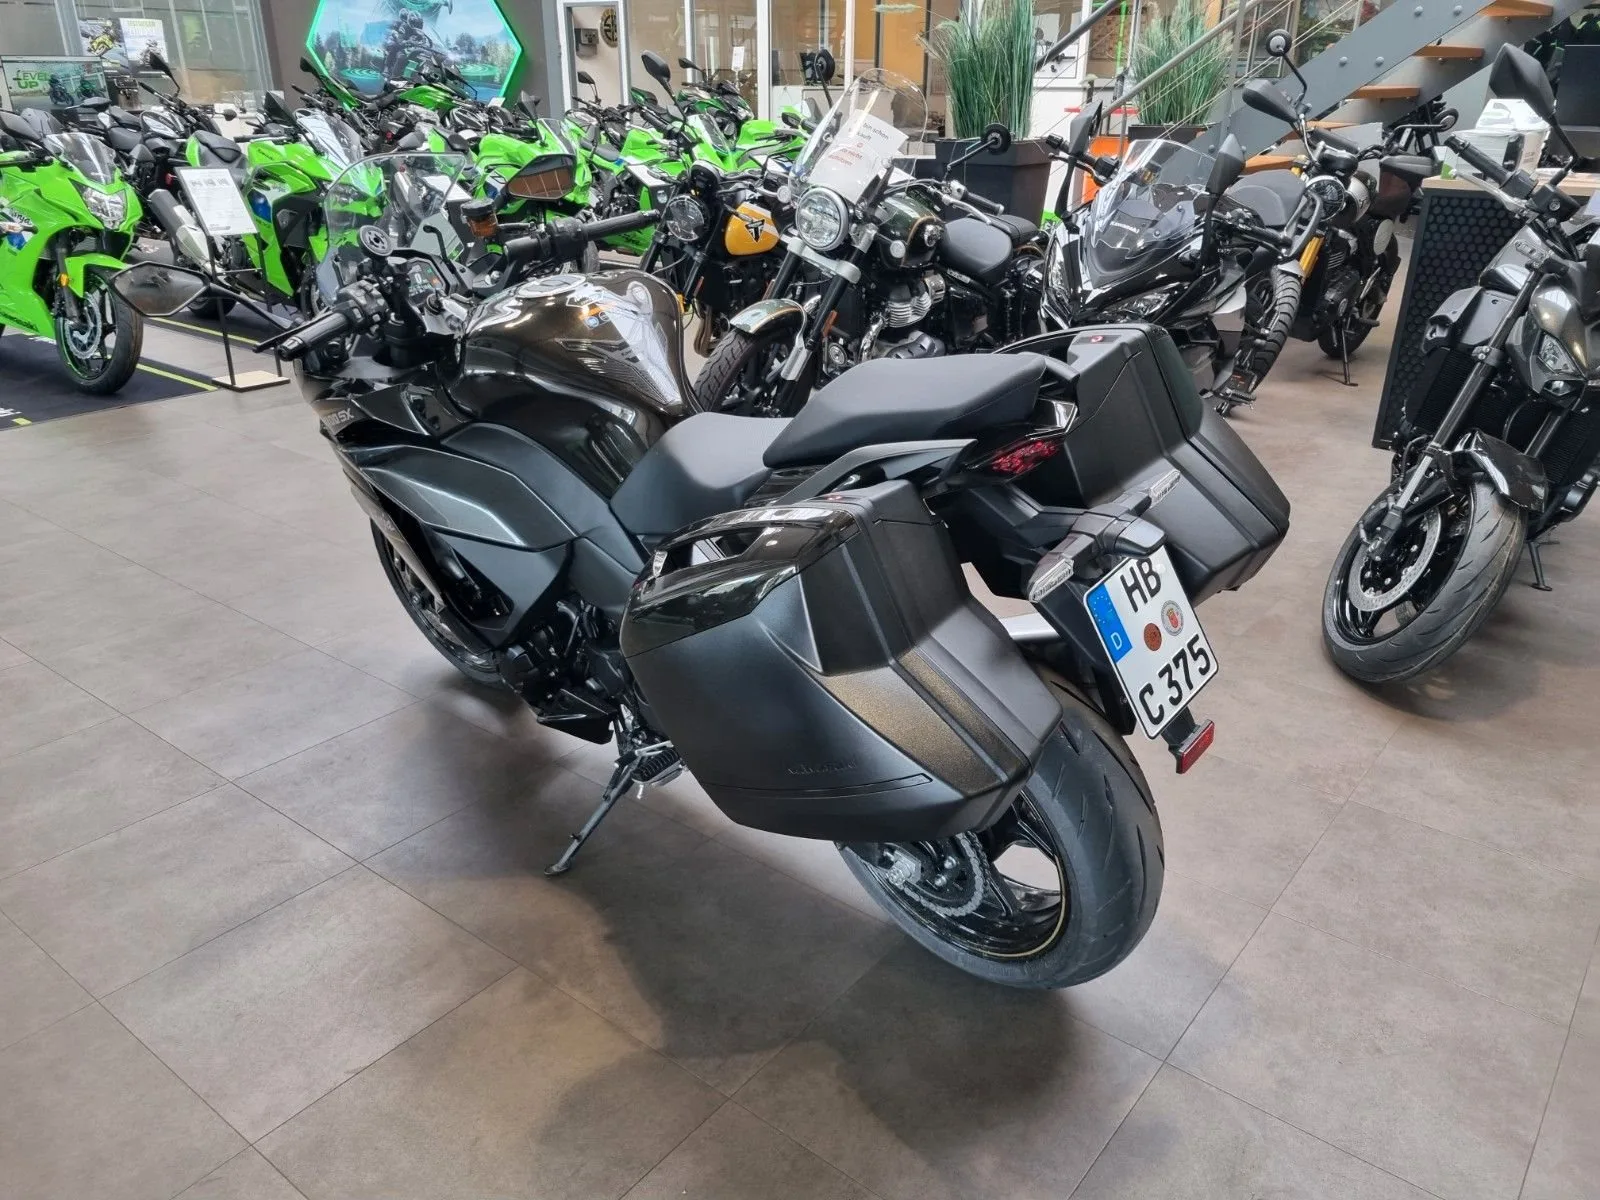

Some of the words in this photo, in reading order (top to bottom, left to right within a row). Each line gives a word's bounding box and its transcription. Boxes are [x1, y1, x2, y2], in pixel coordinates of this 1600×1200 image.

[13, 70, 50, 81] LEVEL
[17, 80, 39, 89] UP
[1119, 557, 1161, 613] HB
[1111, 632, 1123, 651] D
[1138, 683, 1165, 725] C
[1158, 633, 1211, 706] 375
